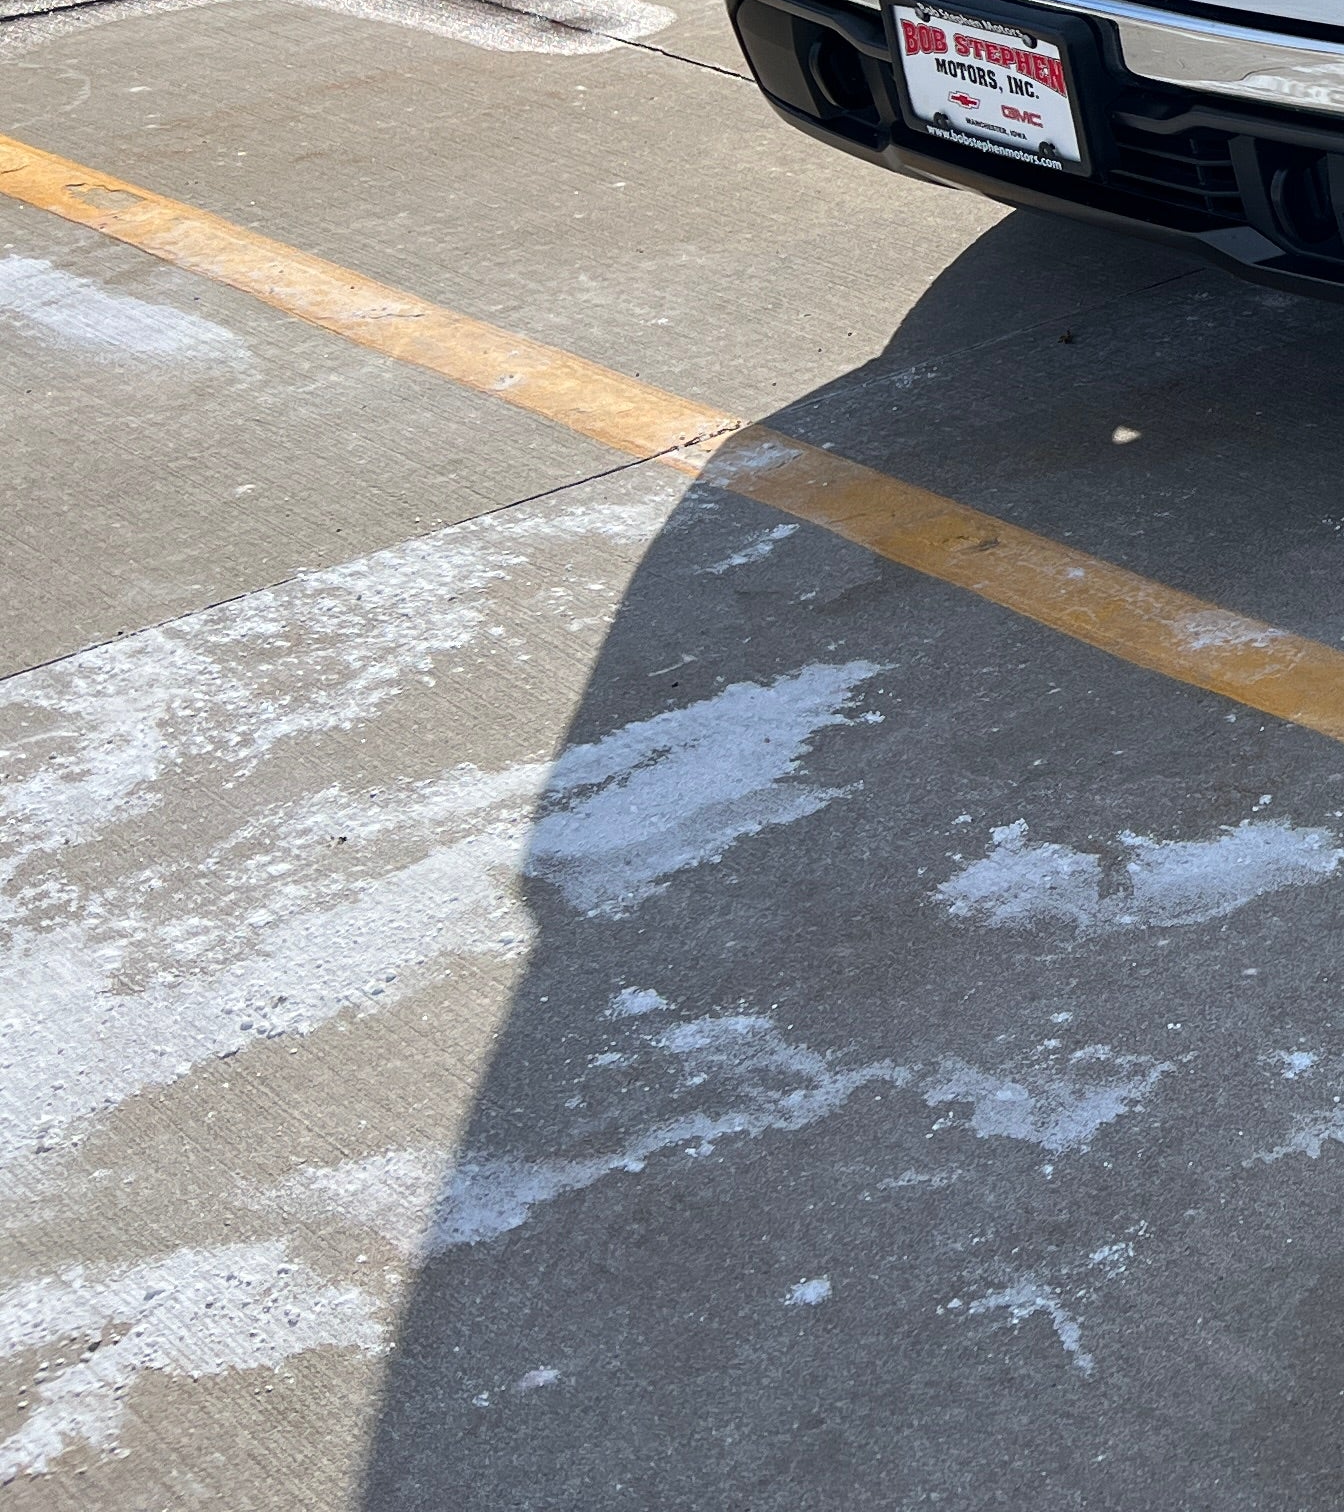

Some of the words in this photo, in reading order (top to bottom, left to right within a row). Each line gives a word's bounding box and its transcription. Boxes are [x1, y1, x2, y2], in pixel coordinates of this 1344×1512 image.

[981, 20, 1023, 39] Motors
[901, 19, 948, 56] BOB
[953, 33, 1067, 99] STEPHEN
[934, 57, 1004, 94] MOTORS,
[1006, 75, 1040, 100] INC.
[1001, 104, 1044, 128] GMC
[926, 124, 1063, 171] www.bobstephenmotors.com
